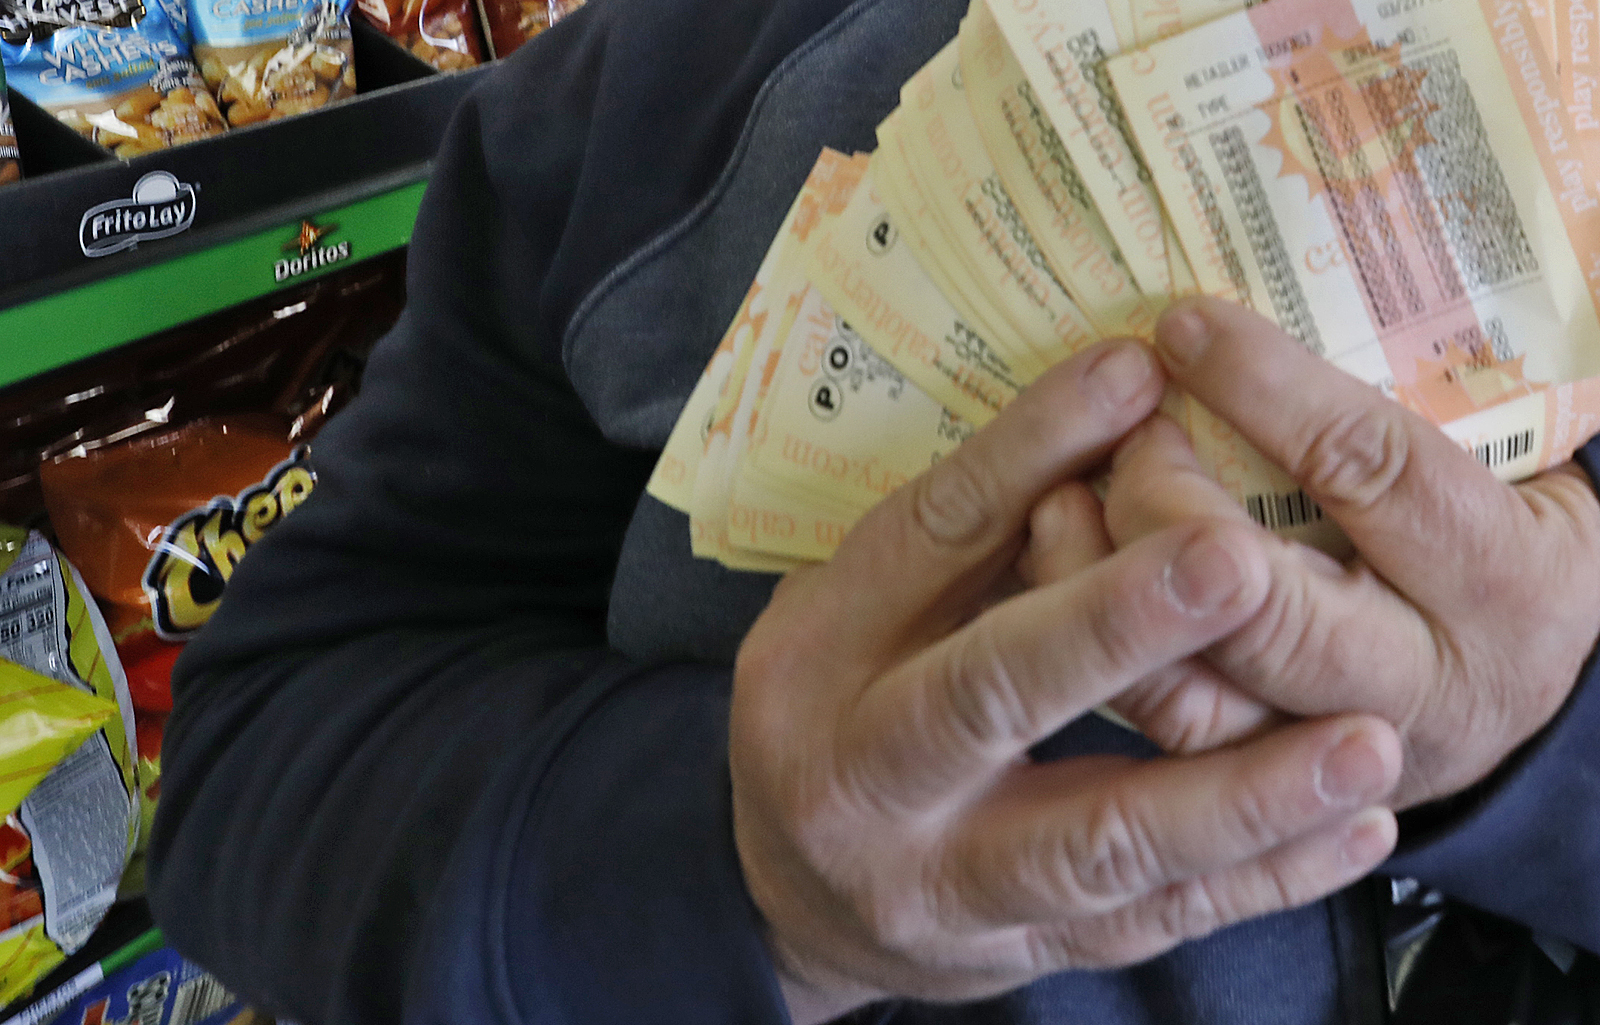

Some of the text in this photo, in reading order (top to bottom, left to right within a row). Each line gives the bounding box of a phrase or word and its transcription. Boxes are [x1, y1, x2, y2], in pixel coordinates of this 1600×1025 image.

[1567, 71, 1600, 131] play
[1554, 158, 1599, 213] play
[274, 240, 350, 283] Doritos
